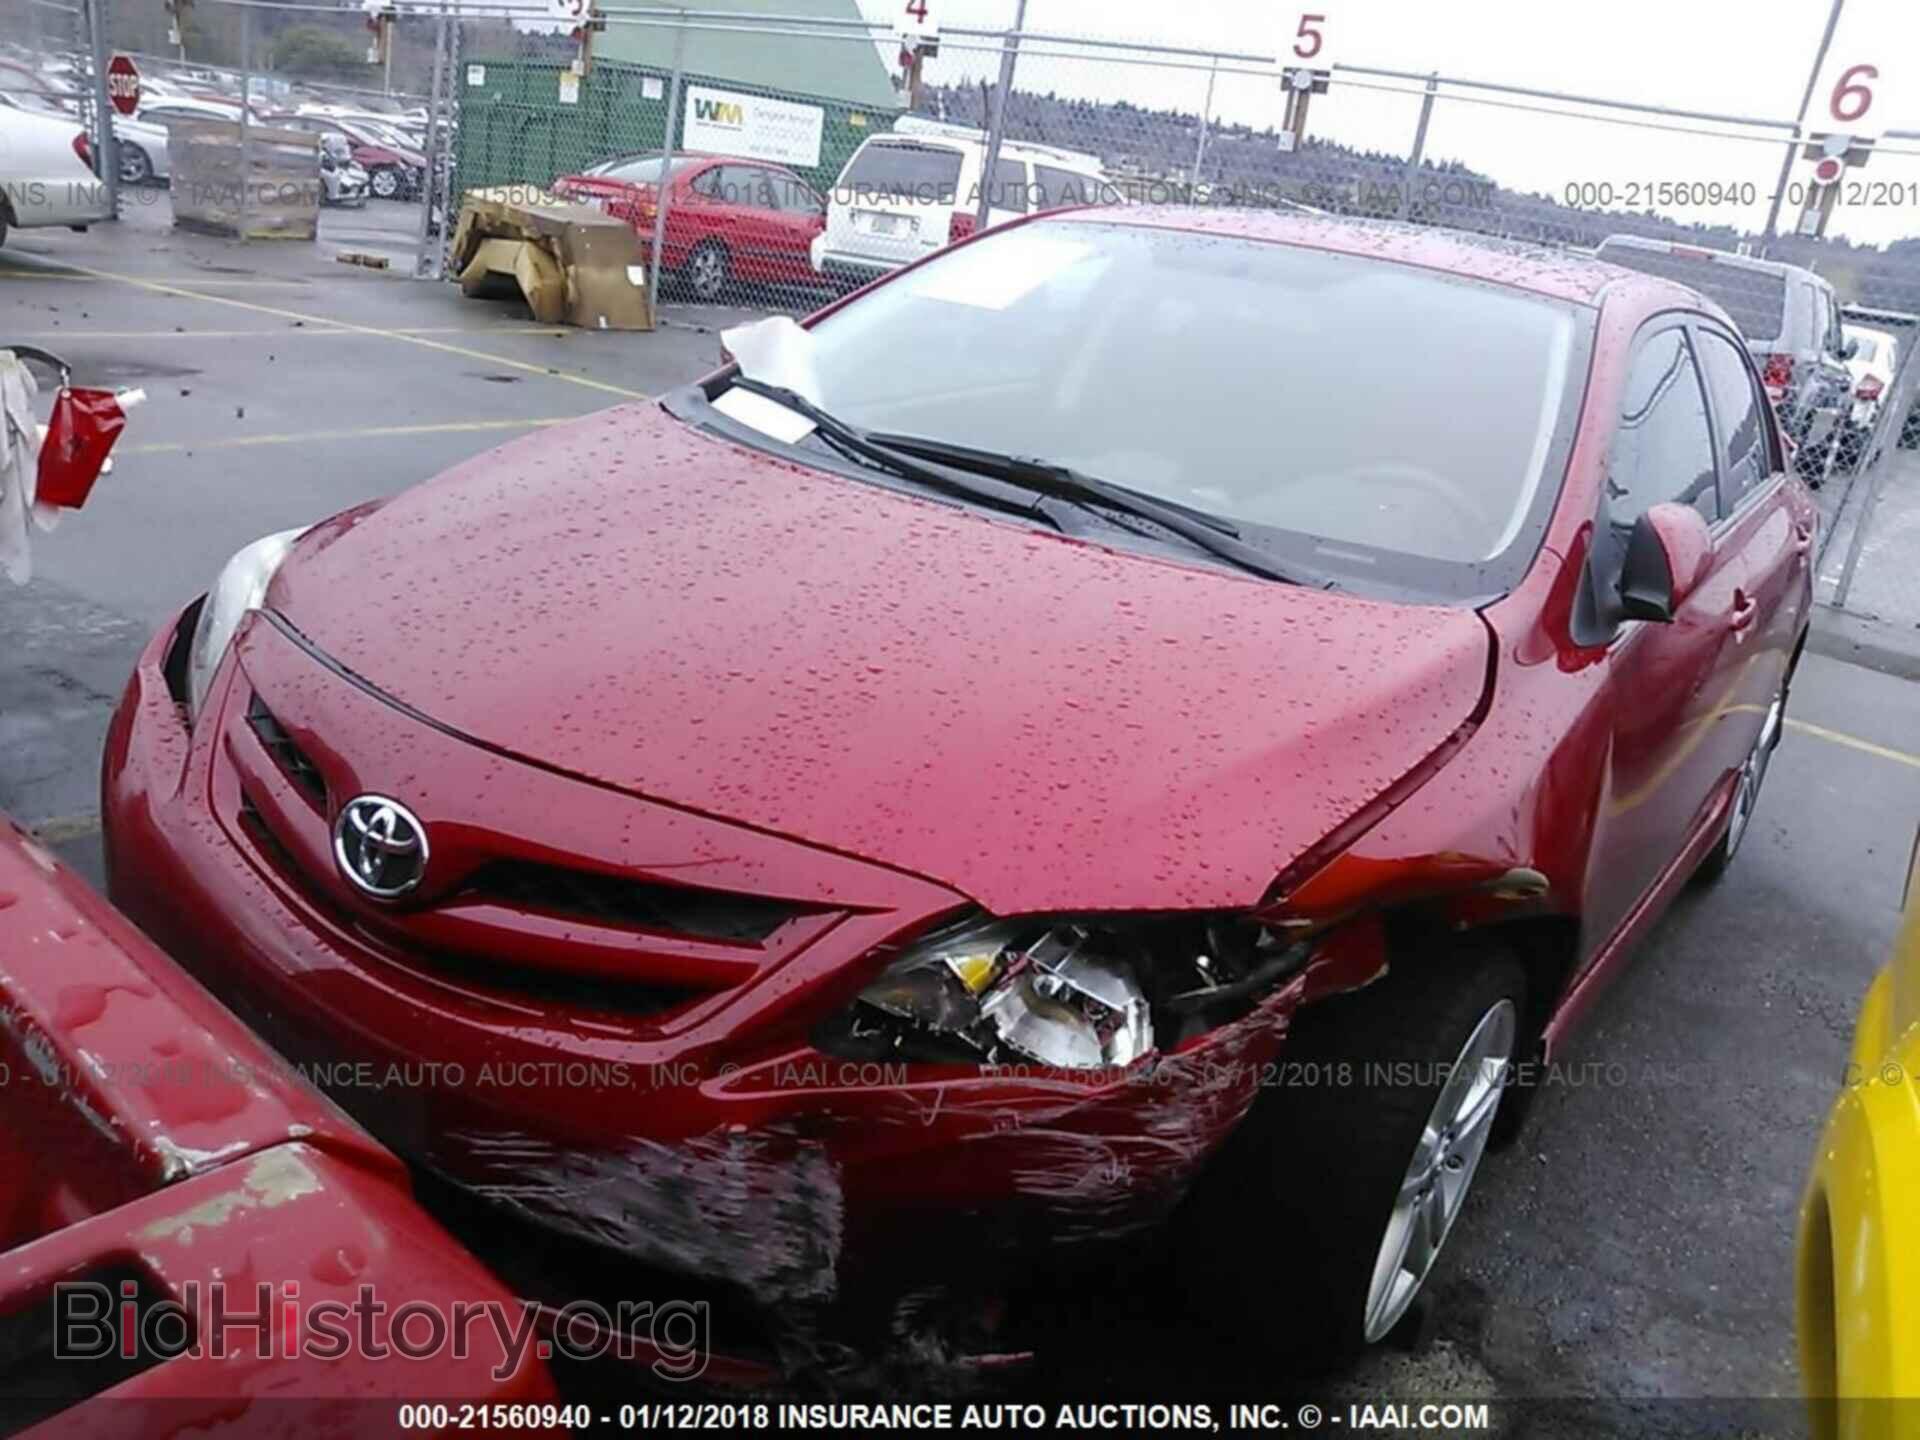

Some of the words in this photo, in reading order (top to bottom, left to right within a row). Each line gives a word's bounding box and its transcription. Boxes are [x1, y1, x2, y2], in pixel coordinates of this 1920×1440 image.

[905, 0, 928, 24] 4
[1293, 14, 1325, 59] 5
[110, 73, 137, 97] STOP
[1830, 64, 1879, 122] 6
[695, 98, 743, 124] WM
